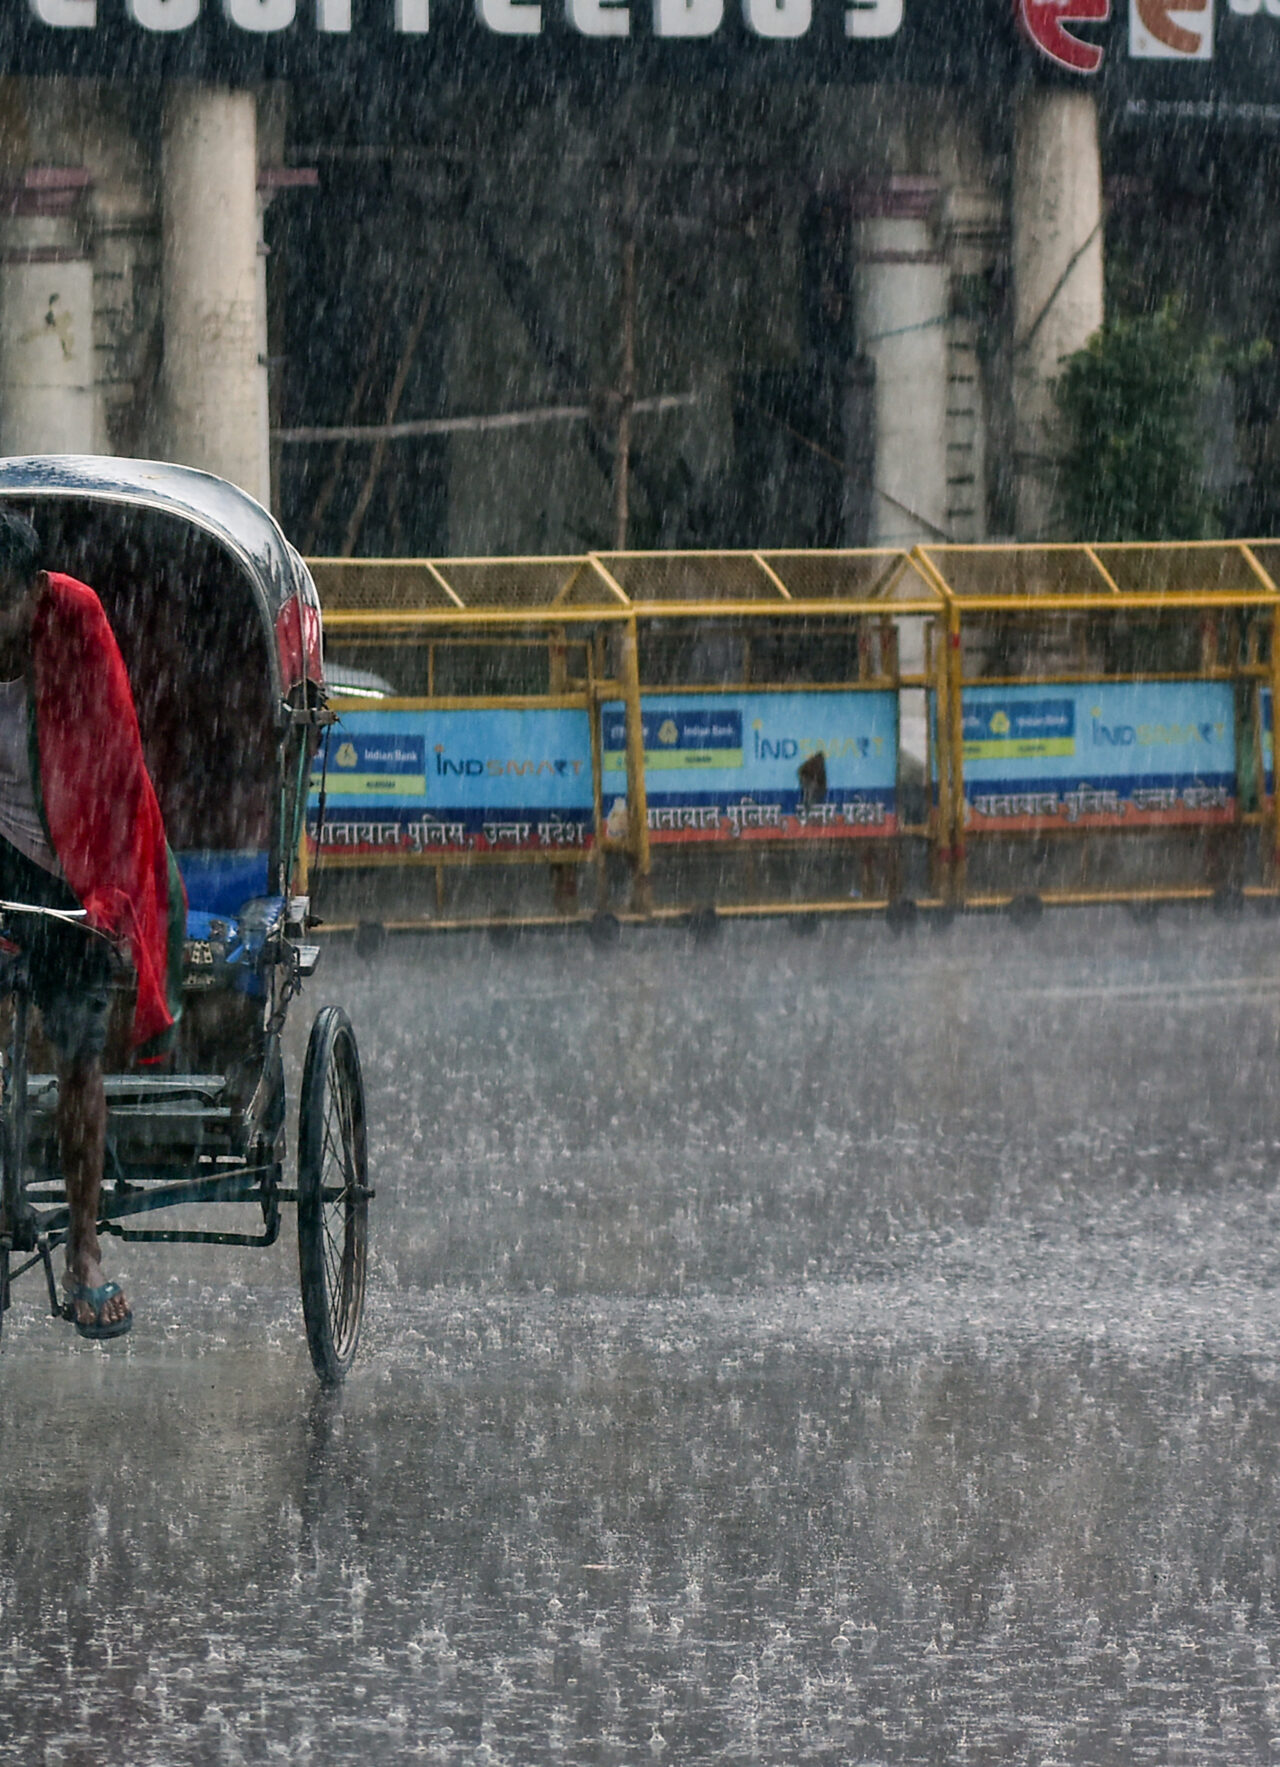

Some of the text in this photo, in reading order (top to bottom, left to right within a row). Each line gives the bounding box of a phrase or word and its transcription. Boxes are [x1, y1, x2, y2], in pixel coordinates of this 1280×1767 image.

[364, 750, 418, 761] Indian Bank
[538, 814, 586, 845] प्रदेश
